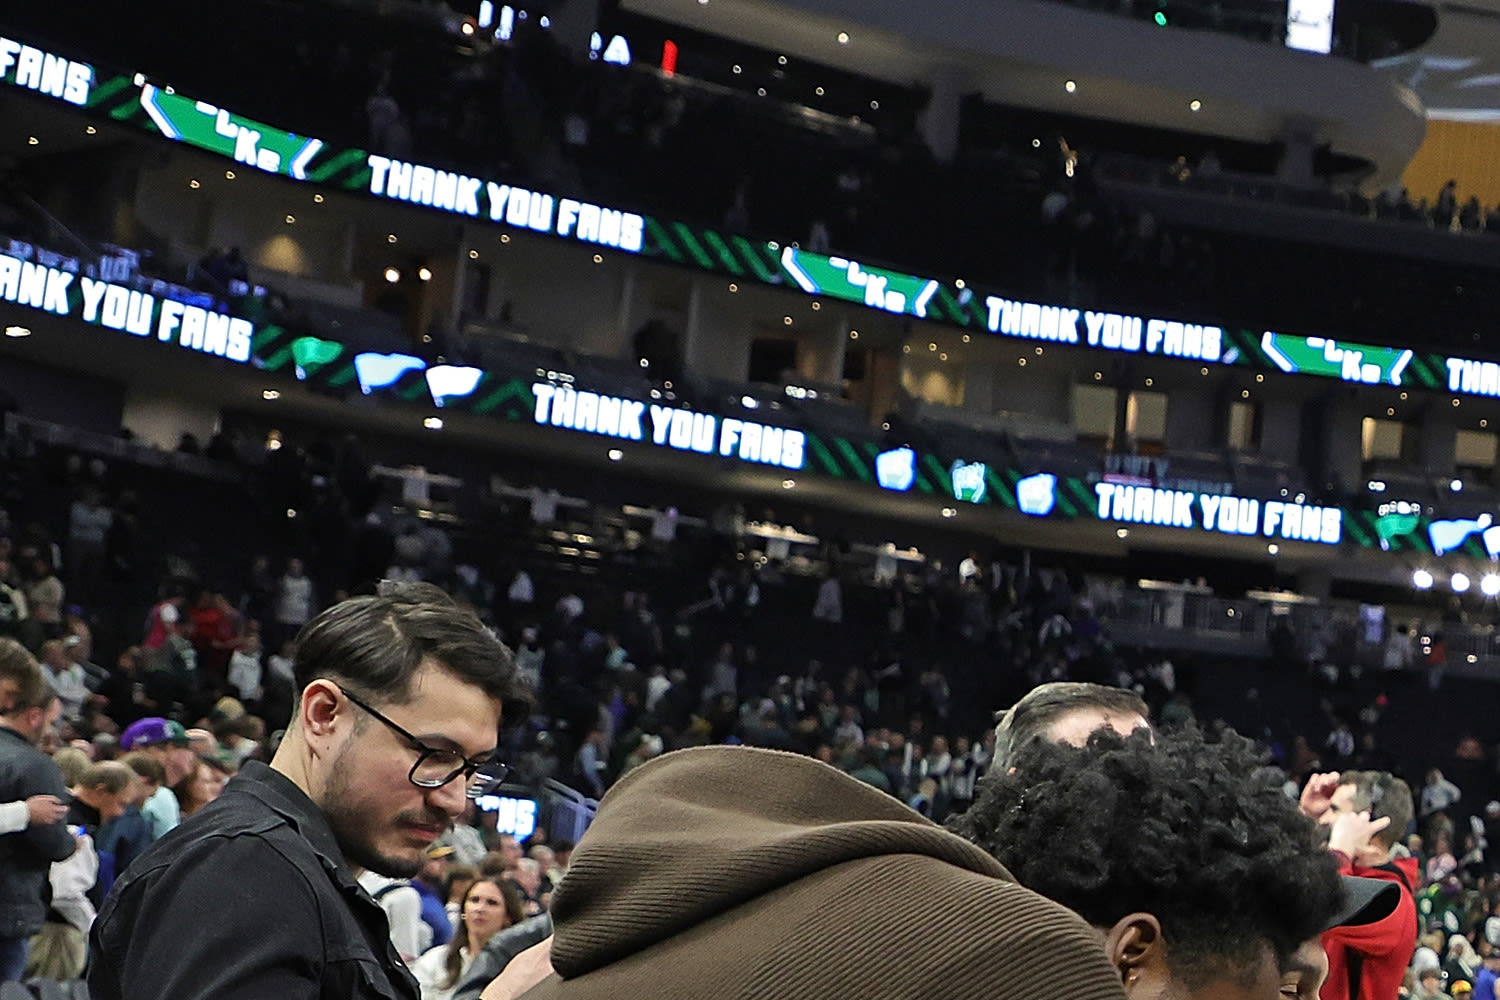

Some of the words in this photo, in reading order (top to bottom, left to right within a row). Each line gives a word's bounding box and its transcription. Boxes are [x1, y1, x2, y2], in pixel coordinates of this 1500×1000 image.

[0, 37, 92, 105] FANS
[367, 154, 482, 215] THANK
[486, 181, 554, 231] YOU
[556, 198, 644, 252] FANS
[0, 254, 74, 315] ANK
[80, 276, 154, 336] YOU
[157, 298, 253, 362] FANS
[985, 295, 1080, 343] THANK
[1084, 310, 1142, 351] YOU
[1145, 318, 1222, 361] FANS
[531, 382, 645, 440] THANK
[649, 404, 716, 453] YOU
[719, 417, 805, 469] FANS
[1095, 481, 1195, 528] THANK
[1199, 493, 1259, 534] YOU
[1263, 501, 1342, 543] FANS
